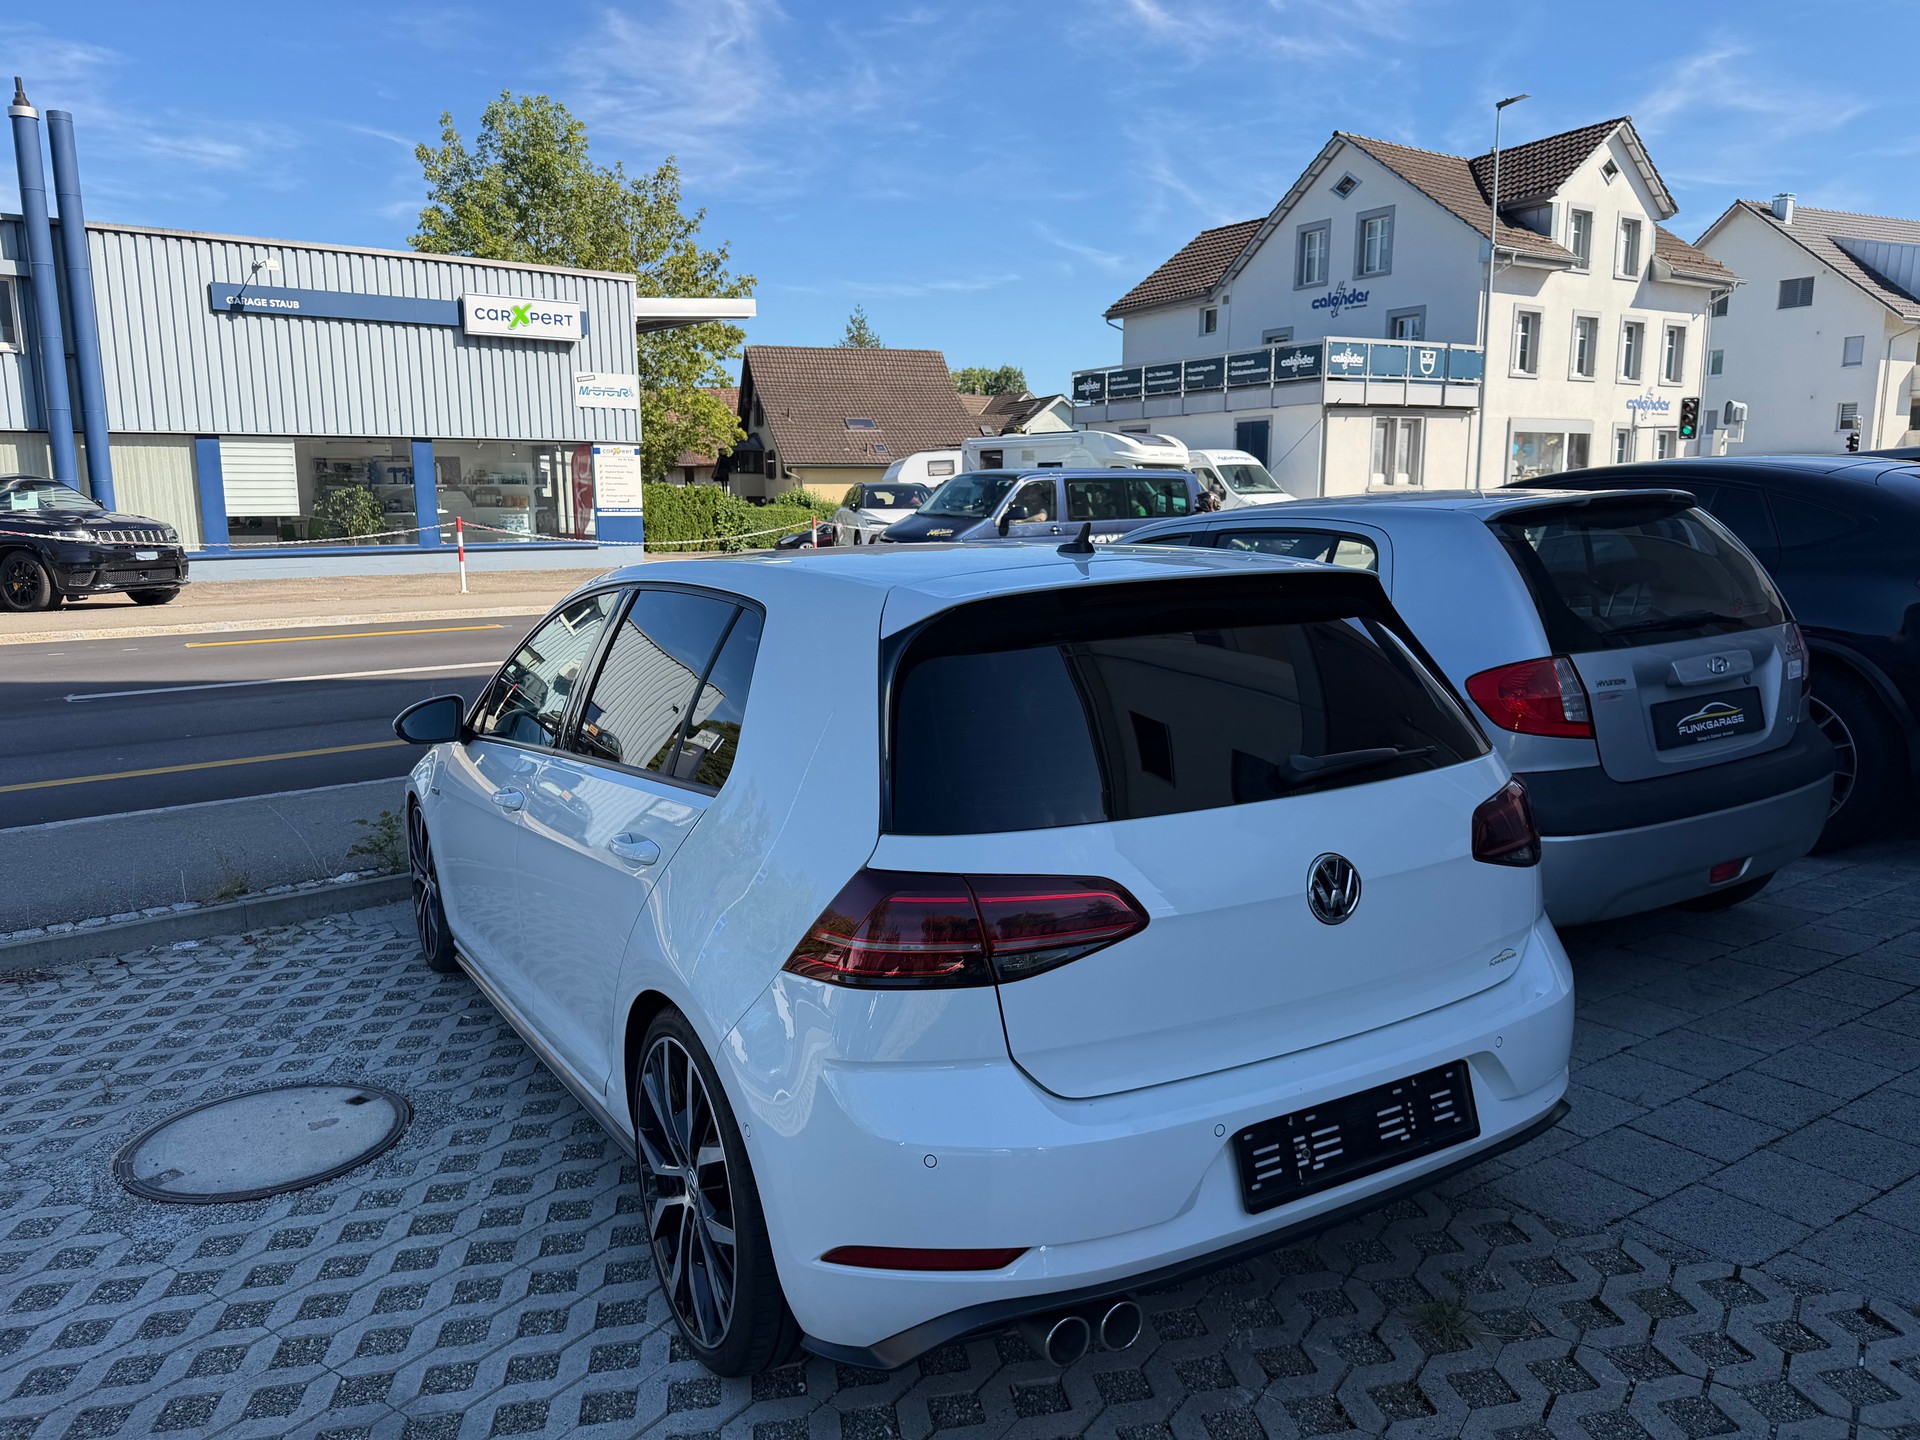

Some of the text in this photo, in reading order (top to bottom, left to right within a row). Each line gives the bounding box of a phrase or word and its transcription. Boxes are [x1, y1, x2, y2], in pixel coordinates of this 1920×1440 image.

[226, 295, 300, 309] GARAGE STAUB
[1678, 714, 1744, 735] FUNKGARAGE
